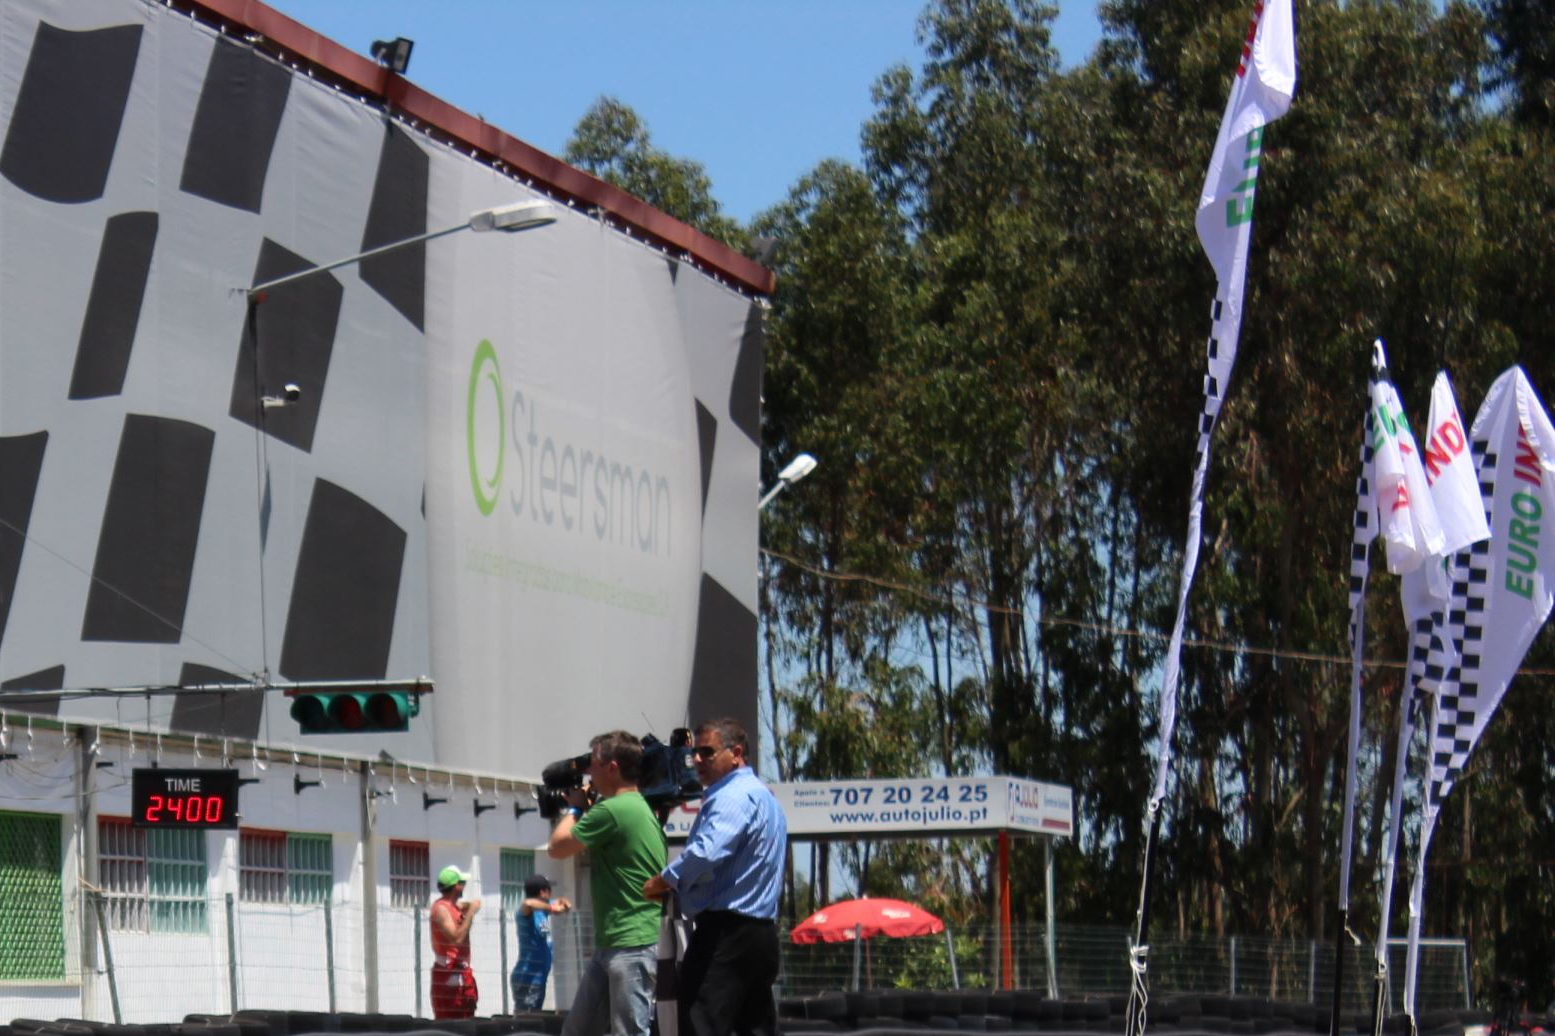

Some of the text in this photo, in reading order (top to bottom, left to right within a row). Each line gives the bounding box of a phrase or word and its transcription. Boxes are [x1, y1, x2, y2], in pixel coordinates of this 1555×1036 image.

[1505, 491, 1543, 601] EURO
[165, 777, 201, 792] TIME
[829, 787, 874, 806] 707
[882, 786, 912, 804] 20
[920, 784, 950, 803] 24
[958, 783, 988, 803] 25
[146, 795, 224, 823] 2400
[829, 805, 989, 825] www.autojulio.pt
